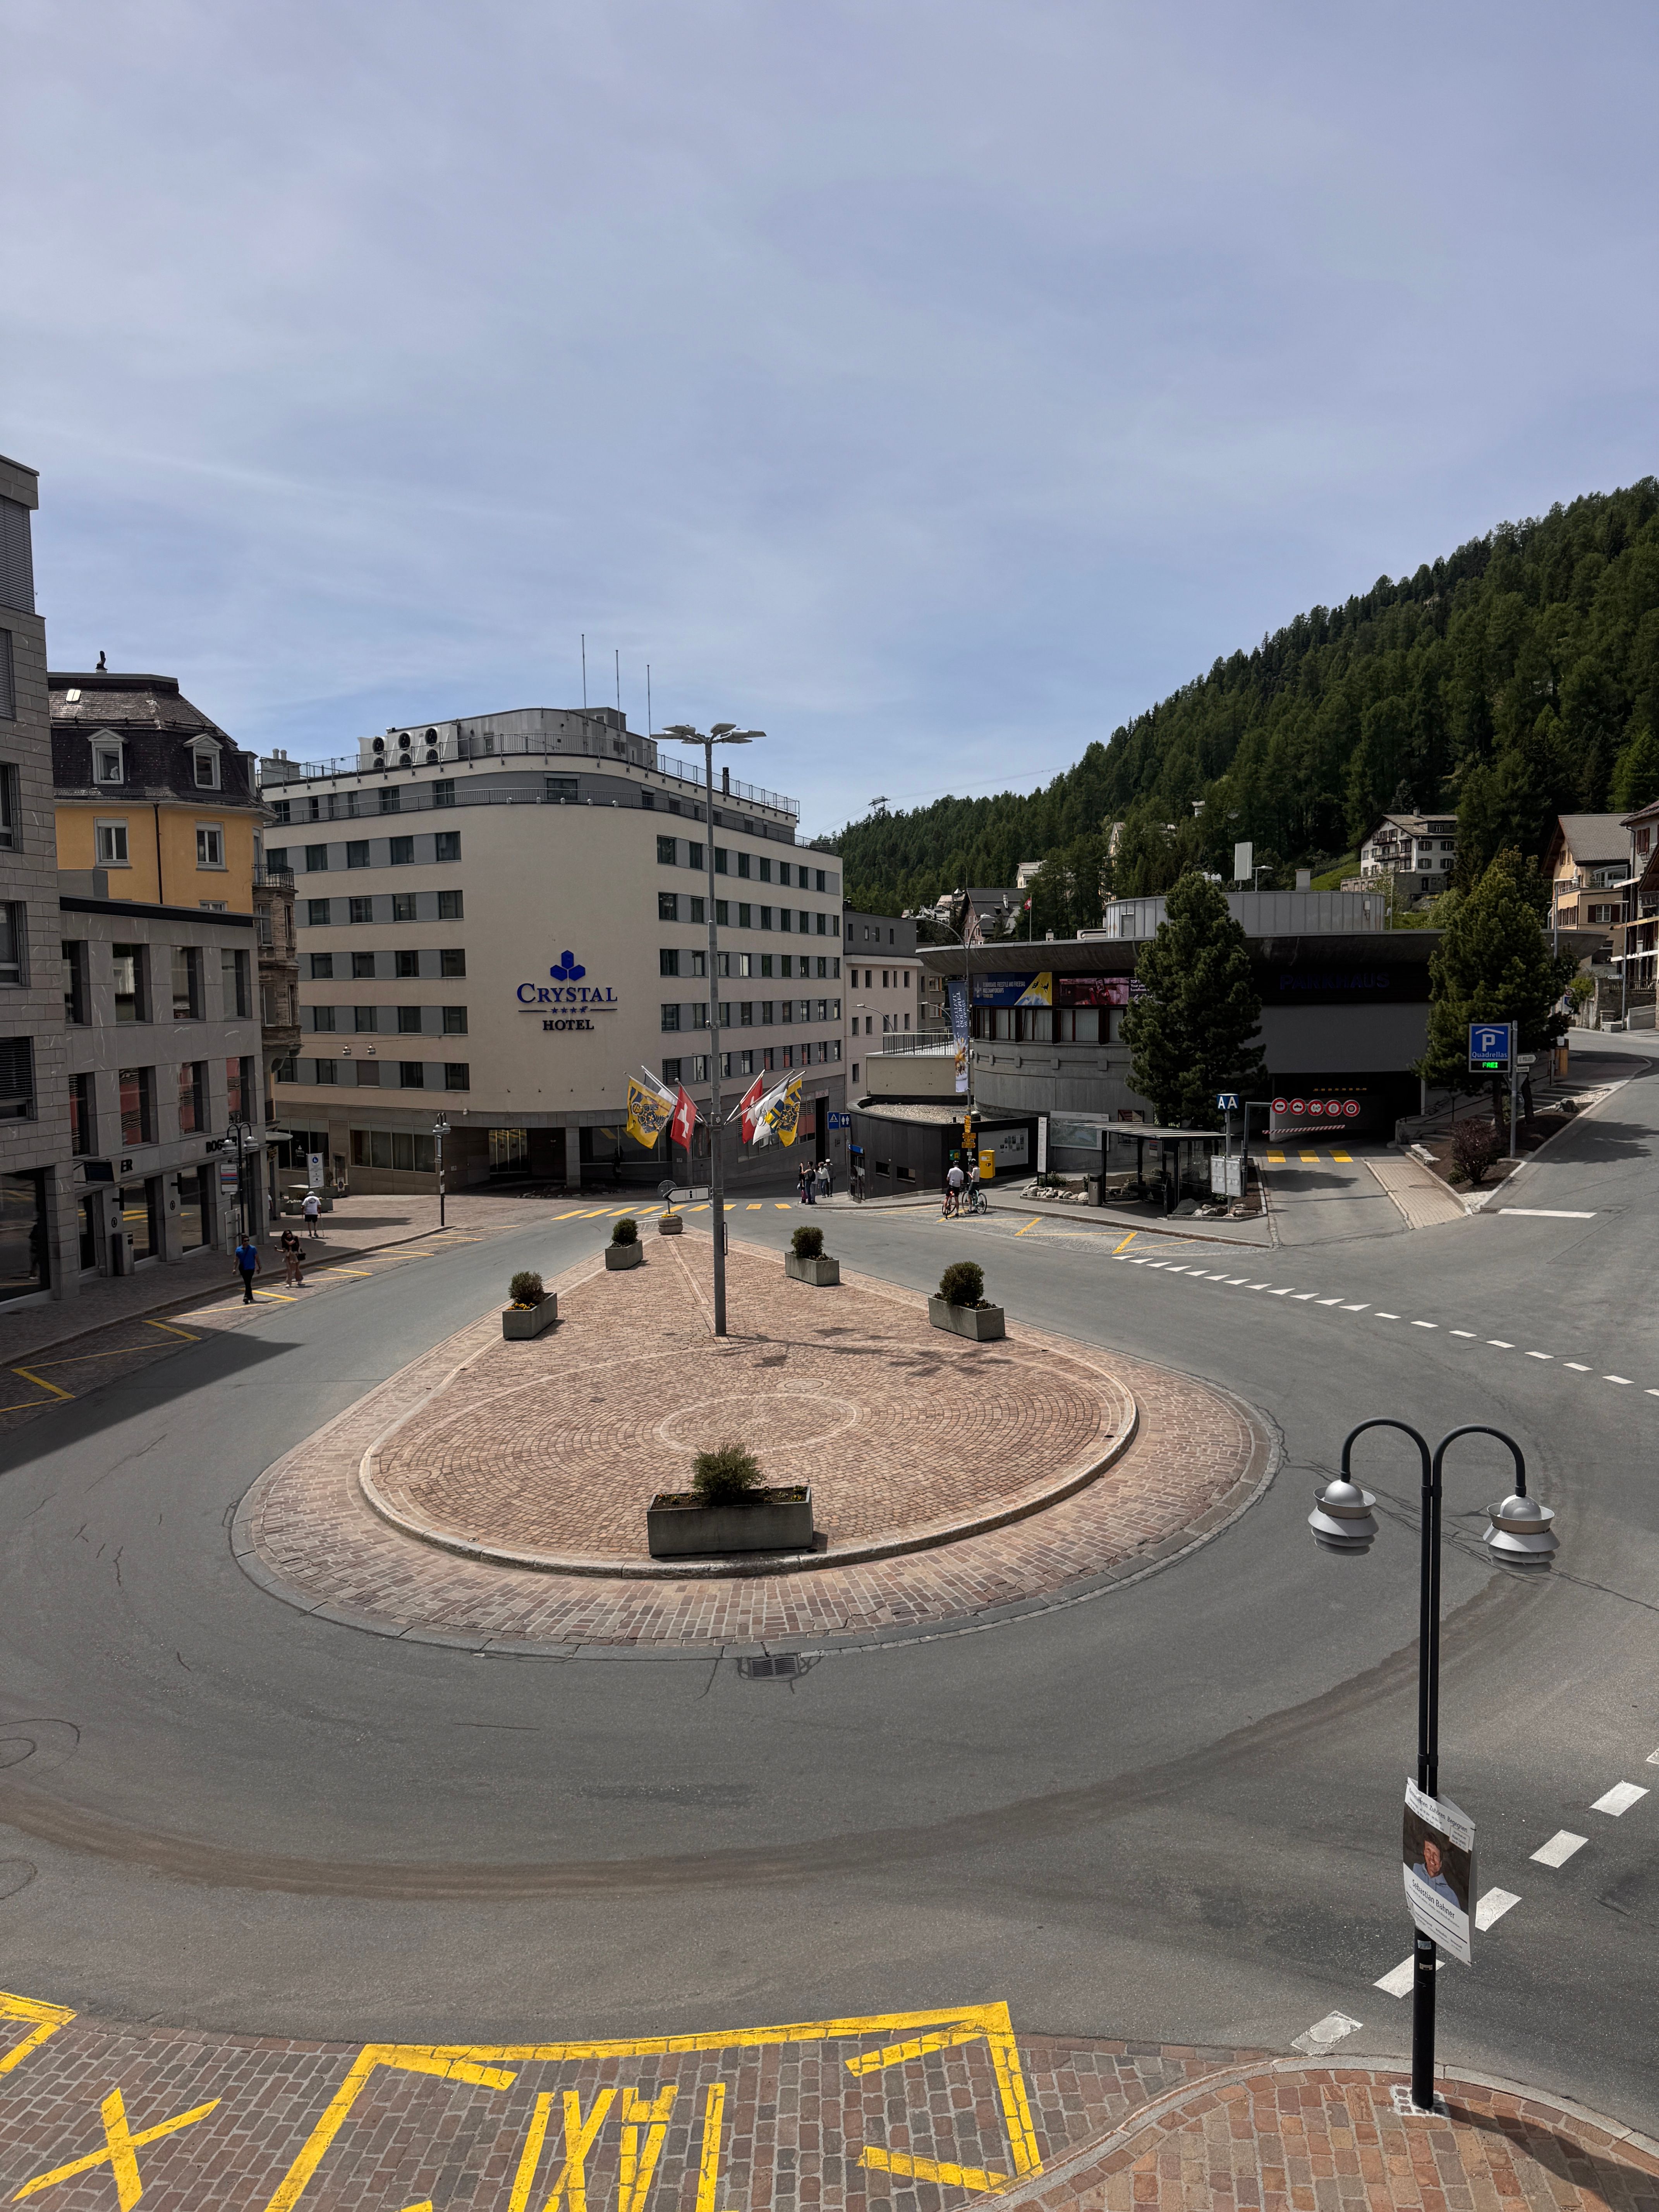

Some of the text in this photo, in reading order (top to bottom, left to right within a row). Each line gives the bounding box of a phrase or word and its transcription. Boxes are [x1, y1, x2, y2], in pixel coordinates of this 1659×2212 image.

[1279, 972, 1390, 989] PARKHAUS
[517, 983, 618, 1003] CRYSTAL
[543, 1019, 594, 1030] HOTEL
[1482, 1034, 1496, 1052] P
[1447, 1816, 1468, 1833] Begegnen
[1412, 1879, 1455, 1919] Sebastian Bahner
